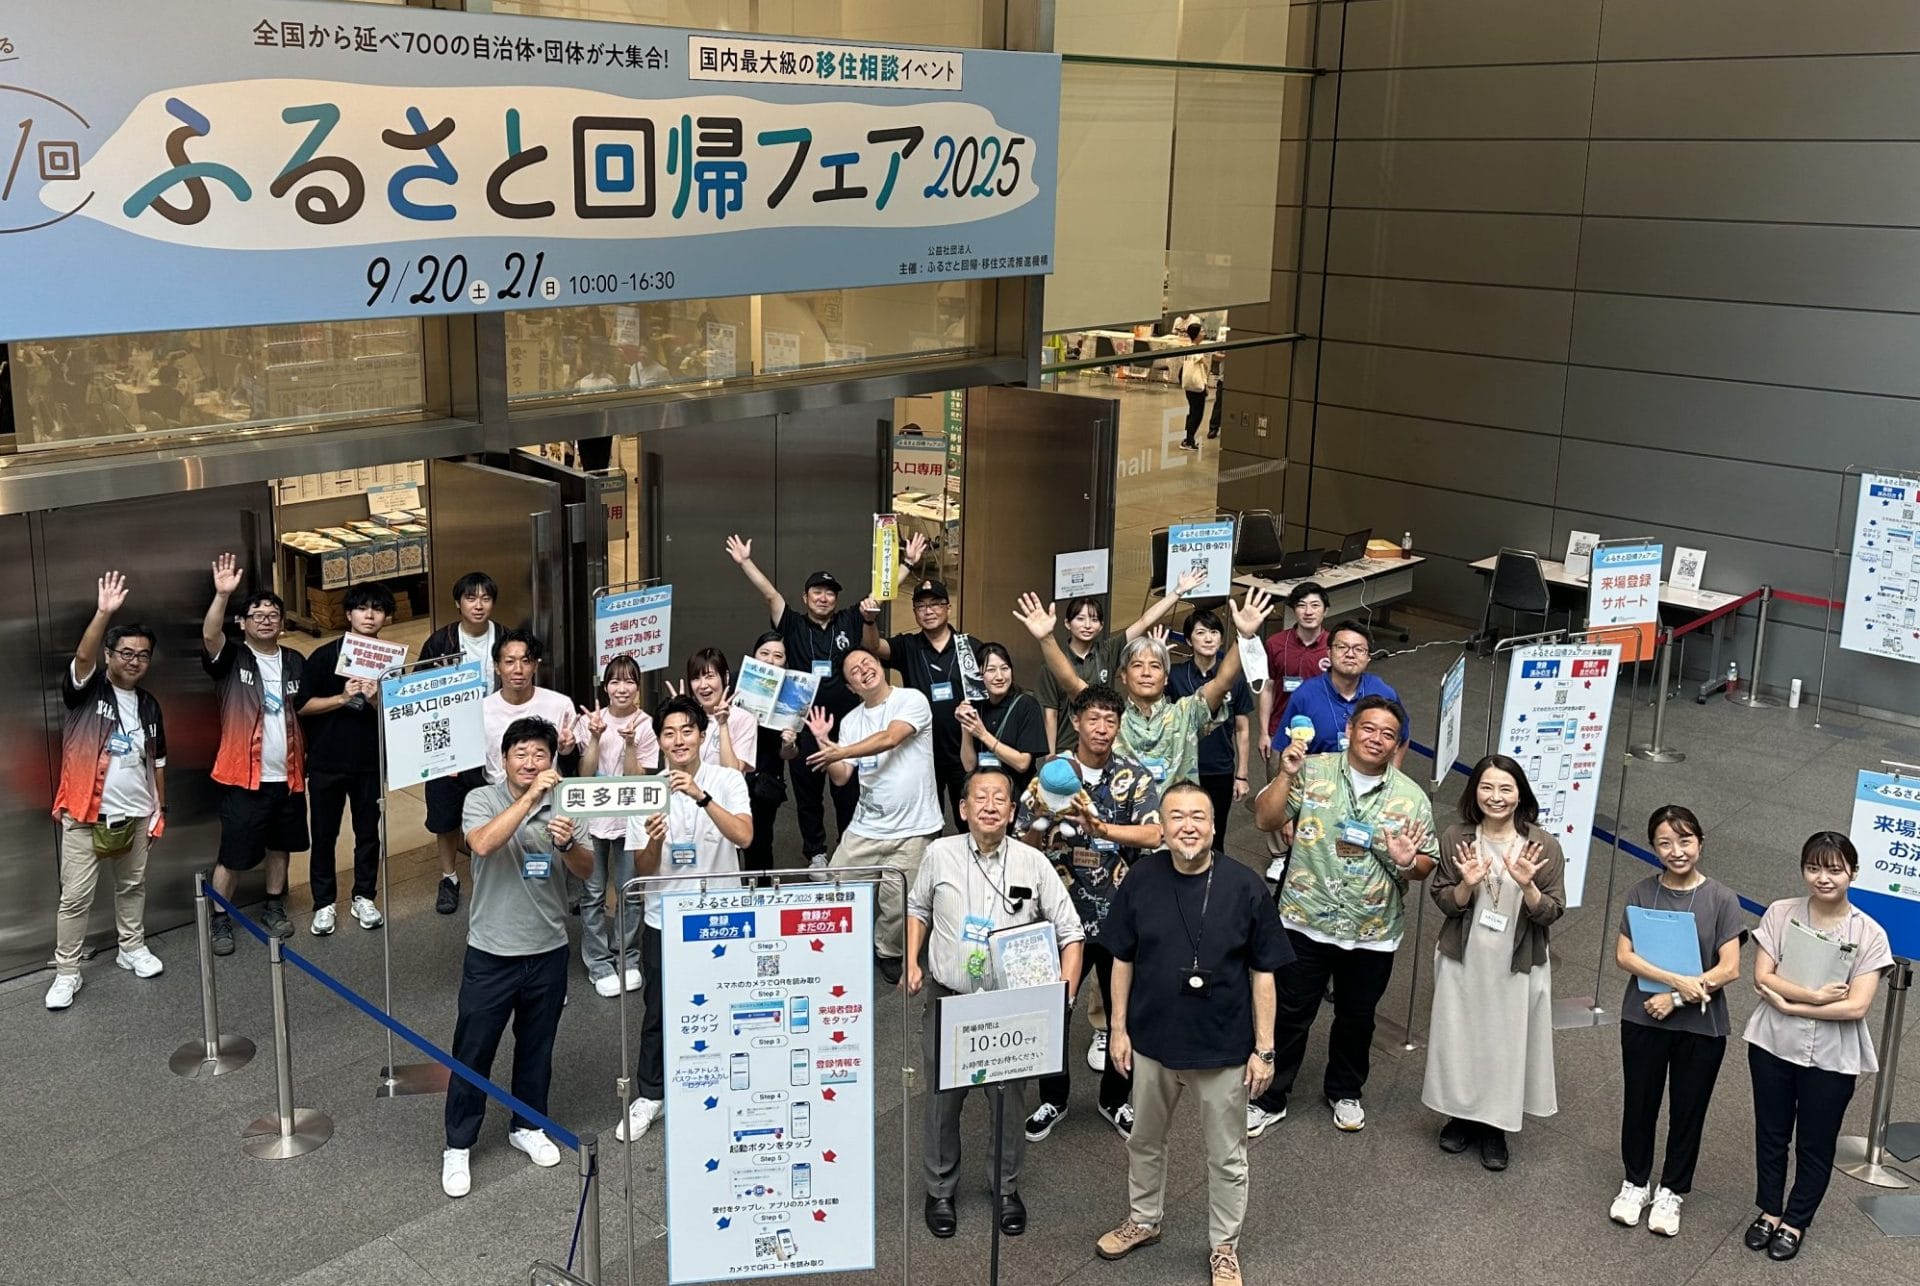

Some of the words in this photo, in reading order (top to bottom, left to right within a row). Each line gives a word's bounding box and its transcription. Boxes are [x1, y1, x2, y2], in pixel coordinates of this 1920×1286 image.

[699, 46, 956, 82] 国内最大級の移住相談イベント
[928, 244, 972, 256] 公益社団法人
[1601, 573, 1652, 590] 来場登録
[1602, 593, 1648, 610] サポート
[610, 614, 657, 633] 会場内での
[605, 629, 661, 649] 営業行為等は
[566, 786, 662, 808] 奥多摩町
[1873, 815, 1920, 839] 来場
[709, 915, 729, 926] 登録
[802, 910, 831, 921] 登録が
[699, 926, 739, 939] 済みの方
[797, 921, 836, 933] まだの方
[757, 943, 774, 951] Step
[758, 990, 774, 998] Step
[681, 1013, 718, 1024] ログイン
[823, 1015, 858, 1025] をタップ
[681, 1024, 719, 1034] をタップ
[829, 1070, 848, 1078] 入力
[759, 1093, 776, 1101] Step
[730, 1139, 812, 1154] 起動ボタンをタップ
[760, 1155, 776, 1163] Step
